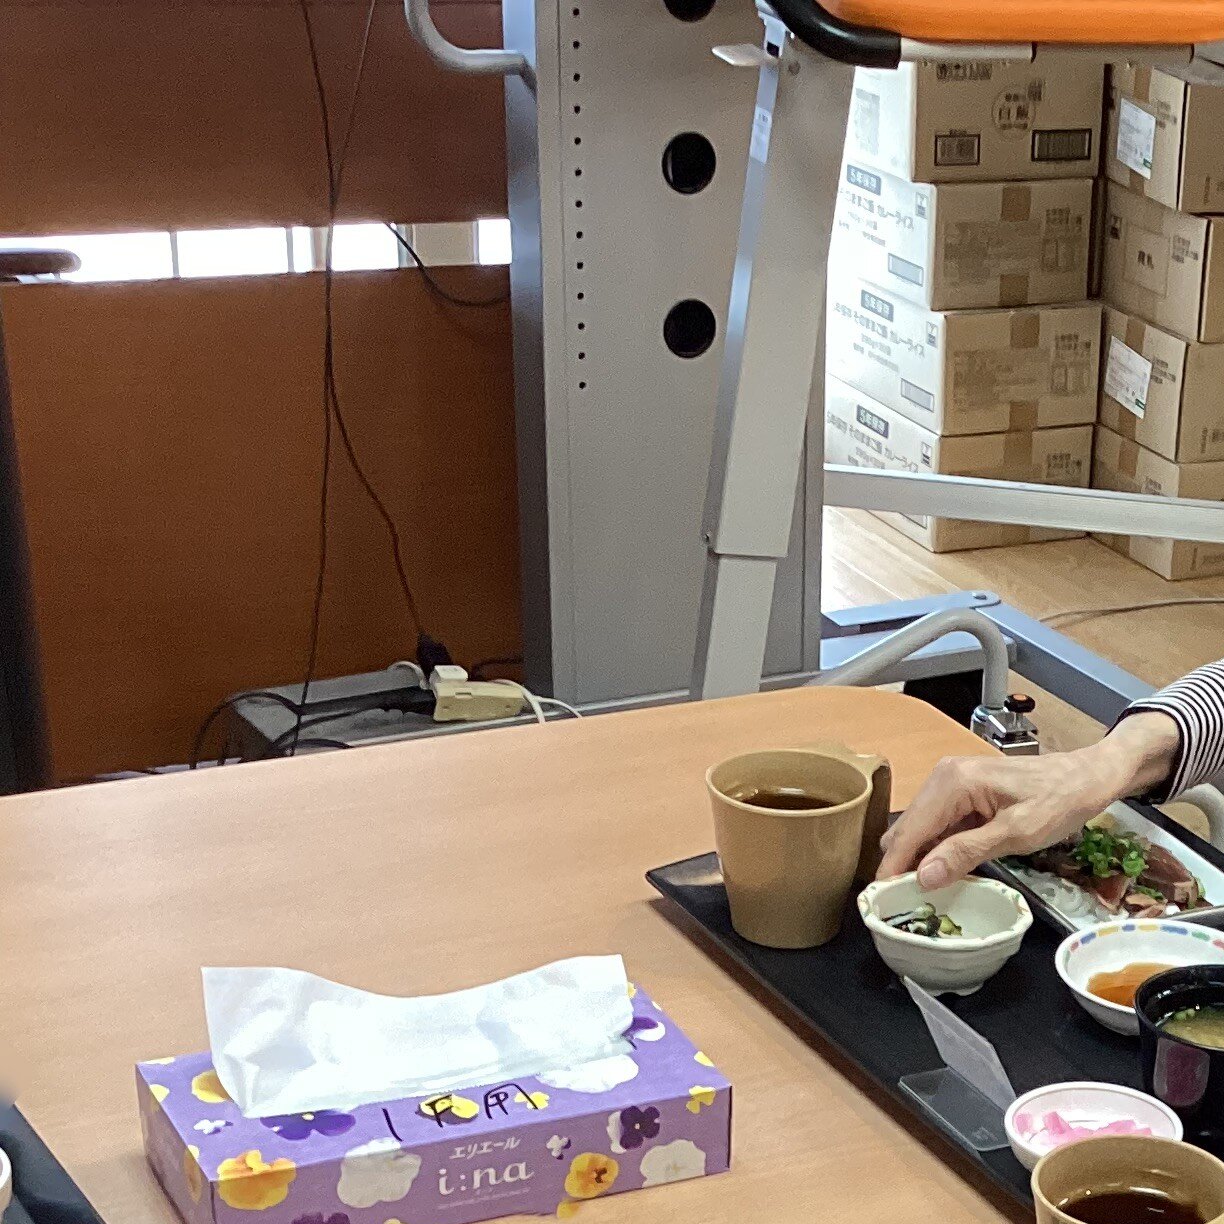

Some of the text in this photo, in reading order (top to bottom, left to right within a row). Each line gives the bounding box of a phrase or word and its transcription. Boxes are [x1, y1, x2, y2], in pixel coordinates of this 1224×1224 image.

[450, 1137, 520, 1159] エリエール
